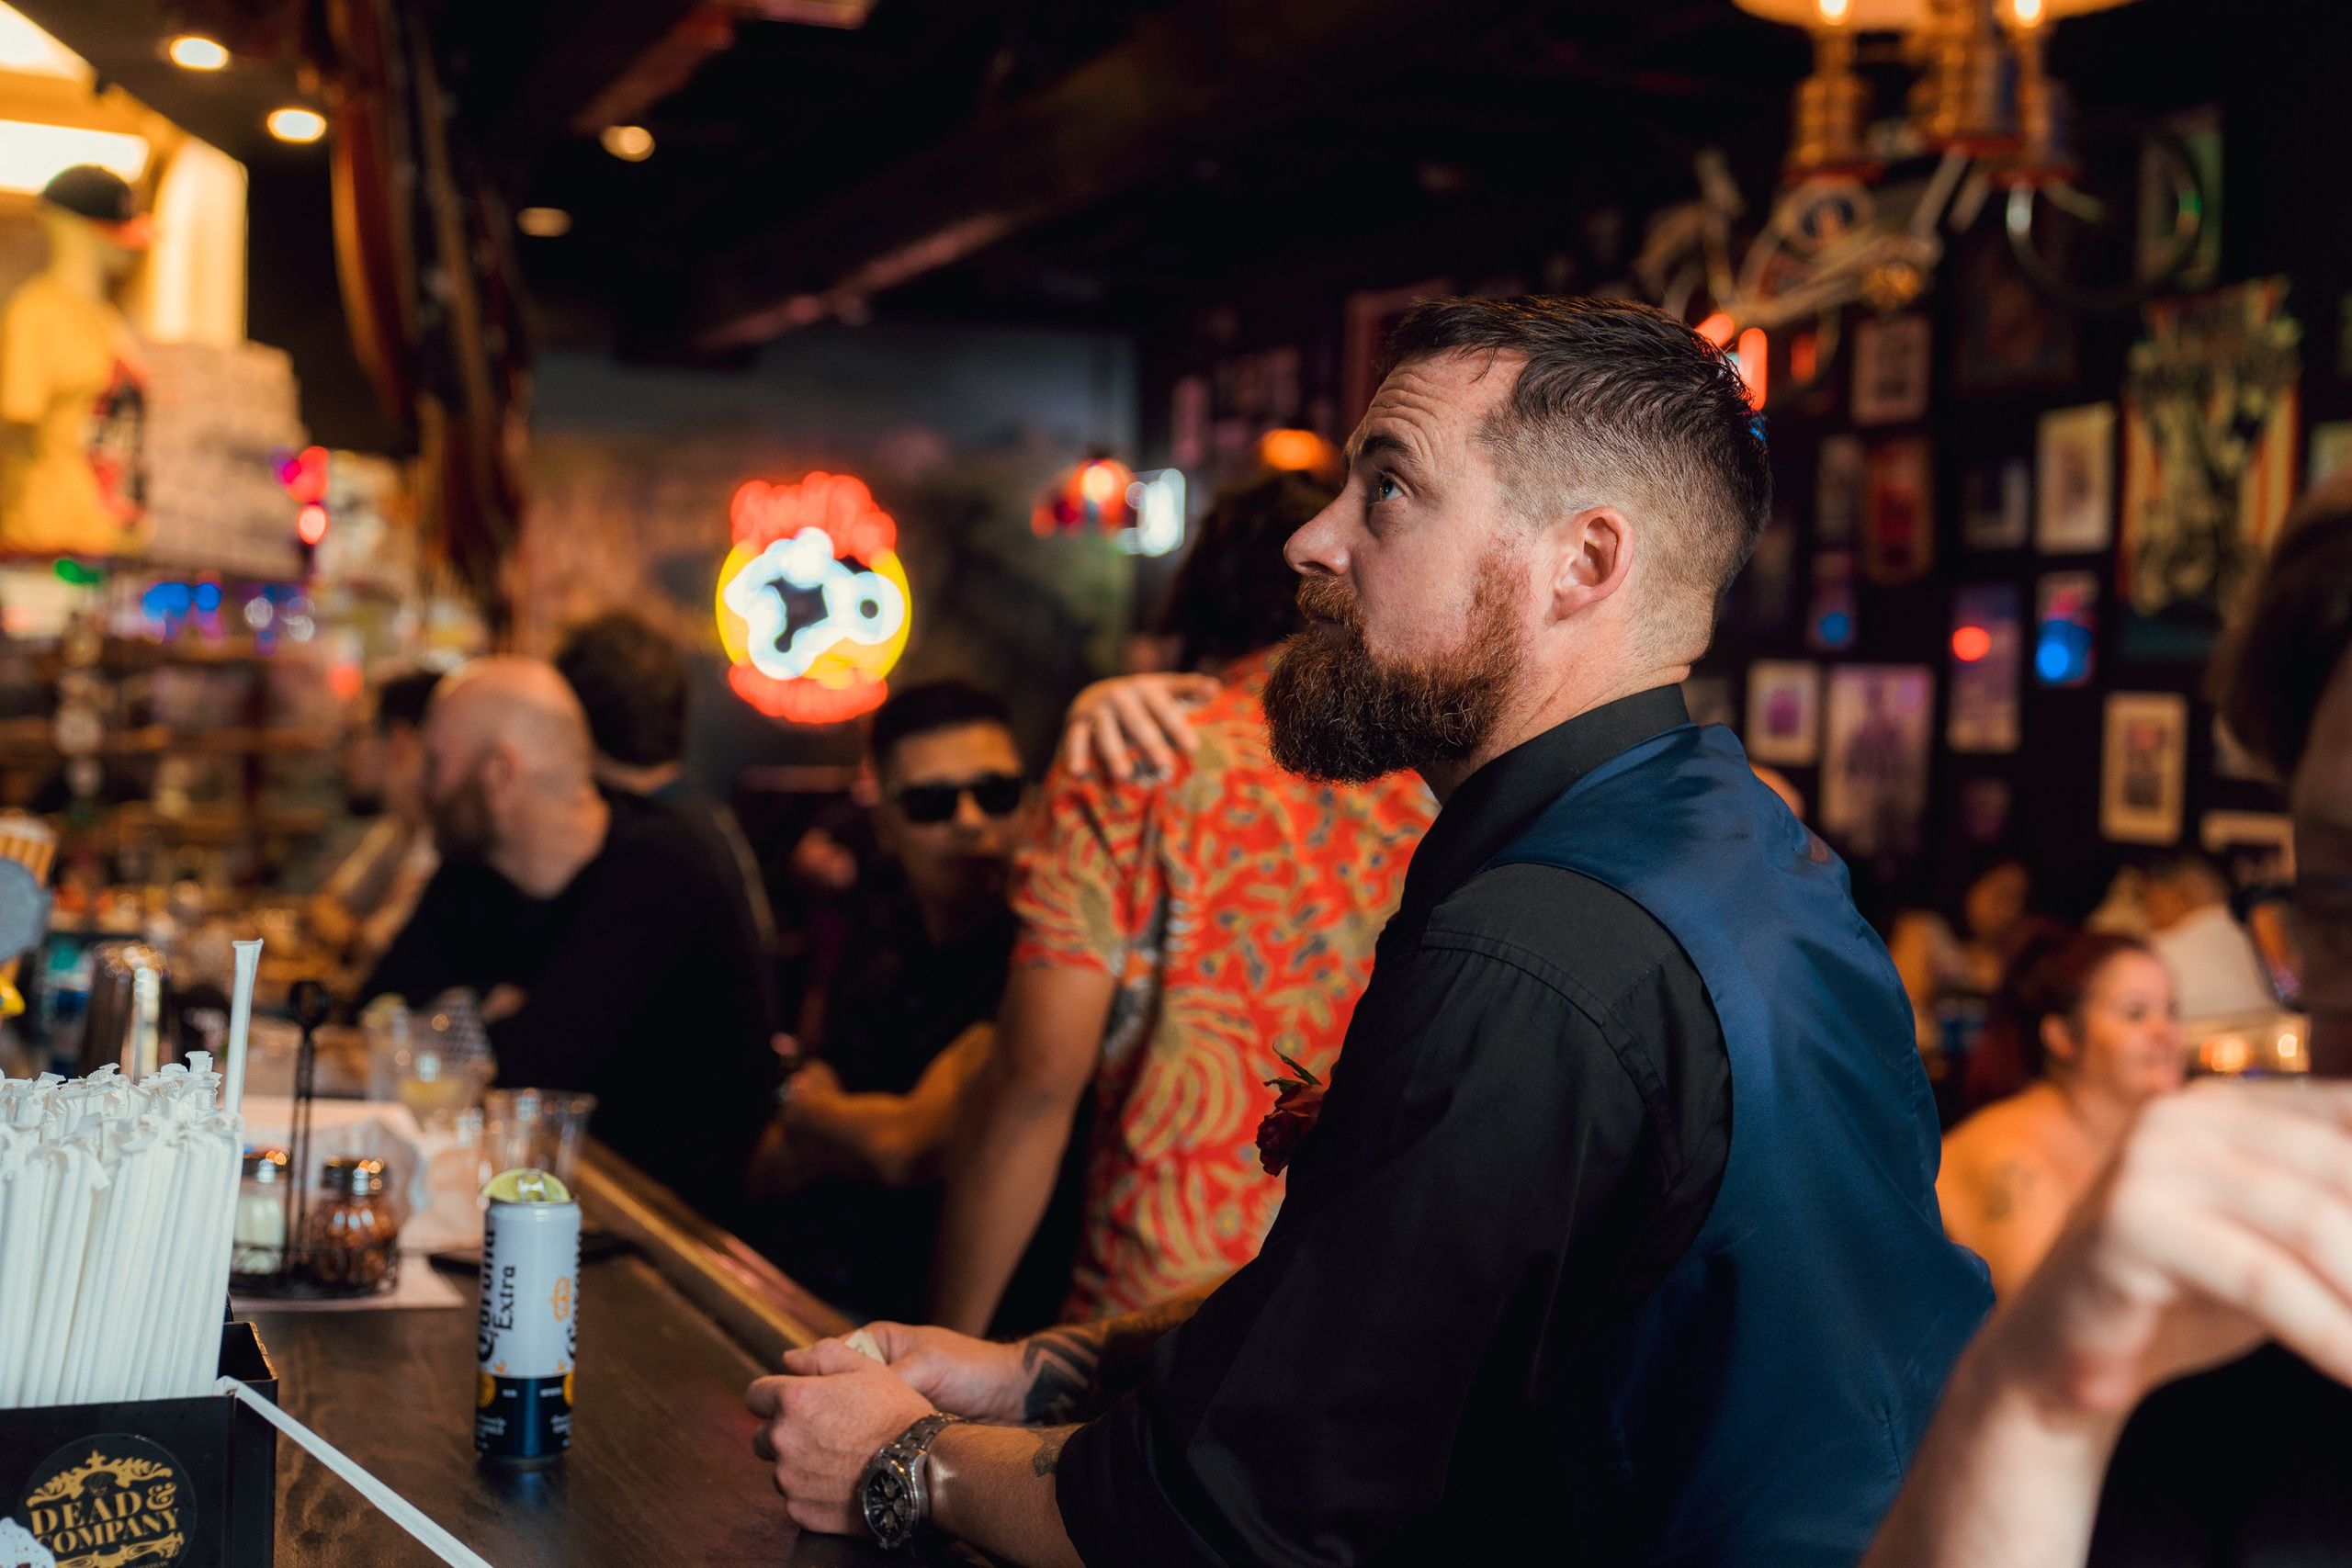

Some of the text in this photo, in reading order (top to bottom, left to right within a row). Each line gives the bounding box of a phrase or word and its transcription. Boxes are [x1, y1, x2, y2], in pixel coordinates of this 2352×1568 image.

[493, 1265, 516, 1330] Extra
[30, 1482, 177, 1535] DEAD &
